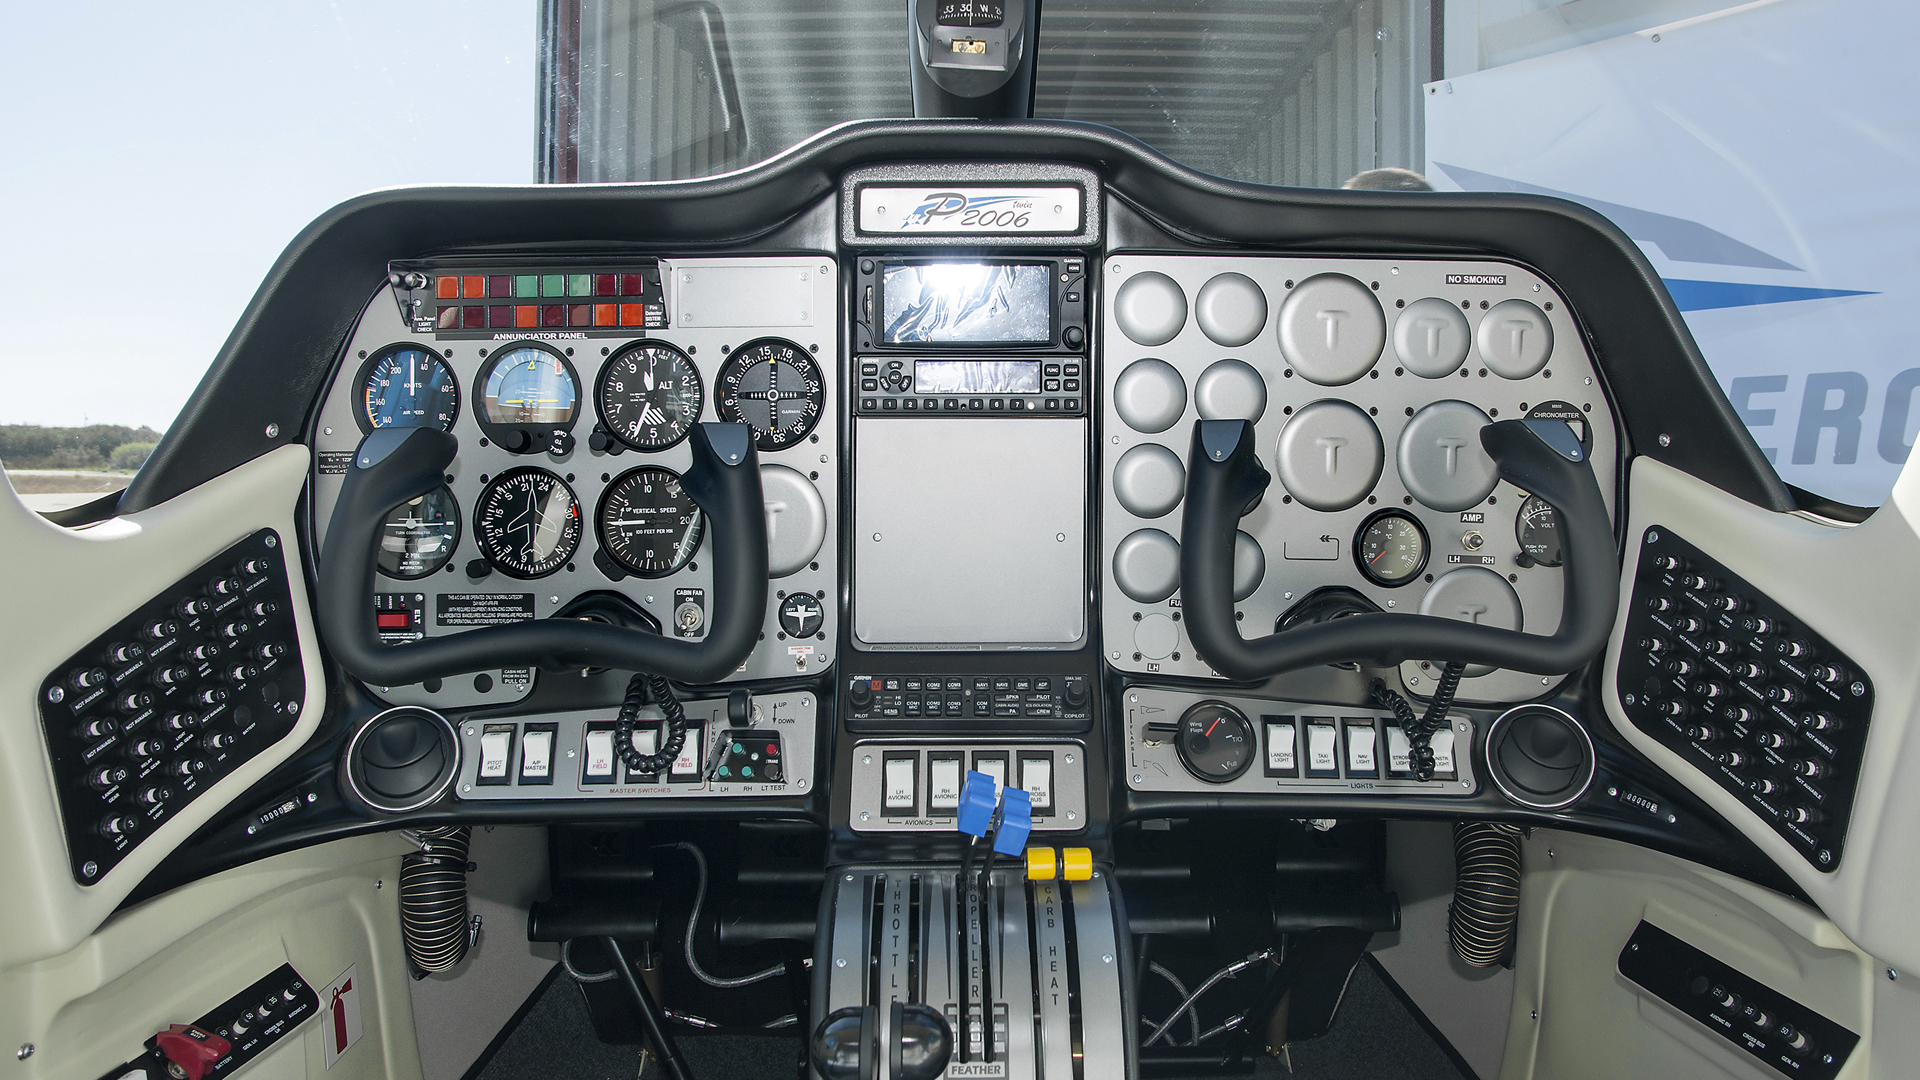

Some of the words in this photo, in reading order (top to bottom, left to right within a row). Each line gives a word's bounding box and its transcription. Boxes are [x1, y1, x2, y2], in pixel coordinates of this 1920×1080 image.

[943, 4, 954, 14] 33
[960, 4, 971, 12] 30
[980, 4, 988, 12] W
[1012, 200, 1033, 209] twin
[1463, 276, 1504, 284] SMOKING
[759, 346, 771, 356] 15
[782, 348, 793, 358] 18
[739, 355, 750, 366] 12
[799, 359, 811, 372] 21
[629, 363, 637, 374] 9
[682, 376, 689, 386] 2
[727, 376, 736, 384] 9
[616, 382, 624, 392] 8
[659, 381, 673, 390] ALT
[811, 380, 820, 394] 24
[375, 398, 385, 406] 160
[615, 404, 622, 414] 7
[682, 405, 690, 415] 3
[809, 403, 818, 417] 27
[438, 413, 447, 421] 80
[629, 421, 637, 431] 6
[670, 420, 679, 430] 4
[794, 422, 806, 435] 30
[650, 428, 658, 438] 5
[773, 433, 785, 443] 33
[520, 482, 530, 492] 21
[537, 482, 549, 492] 24
[644, 485, 652, 493] 10
[504, 492, 513, 501] S
[555, 491, 565, 502] W
[495, 508, 504, 518] 15
[564, 508, 573, 520] 30
[680, 516, 690, 525] 20
[495, 528, 503, 537] 12
[563, 527, 573, 539] 33
[503, 545, 513, 554] E
[555, 545, 564, 555] N
[673, 542, 680, 550] 15
[520, 555, 527, 563] 6
[541, 555, 547, 563] 3
[646, 550, 654, 558] 10
[115, 769, 127, 781] 20
[1044, 886, 1055, 928] CARB
[1049, 945, 1058, 1005] HEAT
[1780, 1026, 1789, 1035] 50
[214, 1055, 233, 1070] BATTERY
[951, 1065, 1001, 1075] FEATHER
